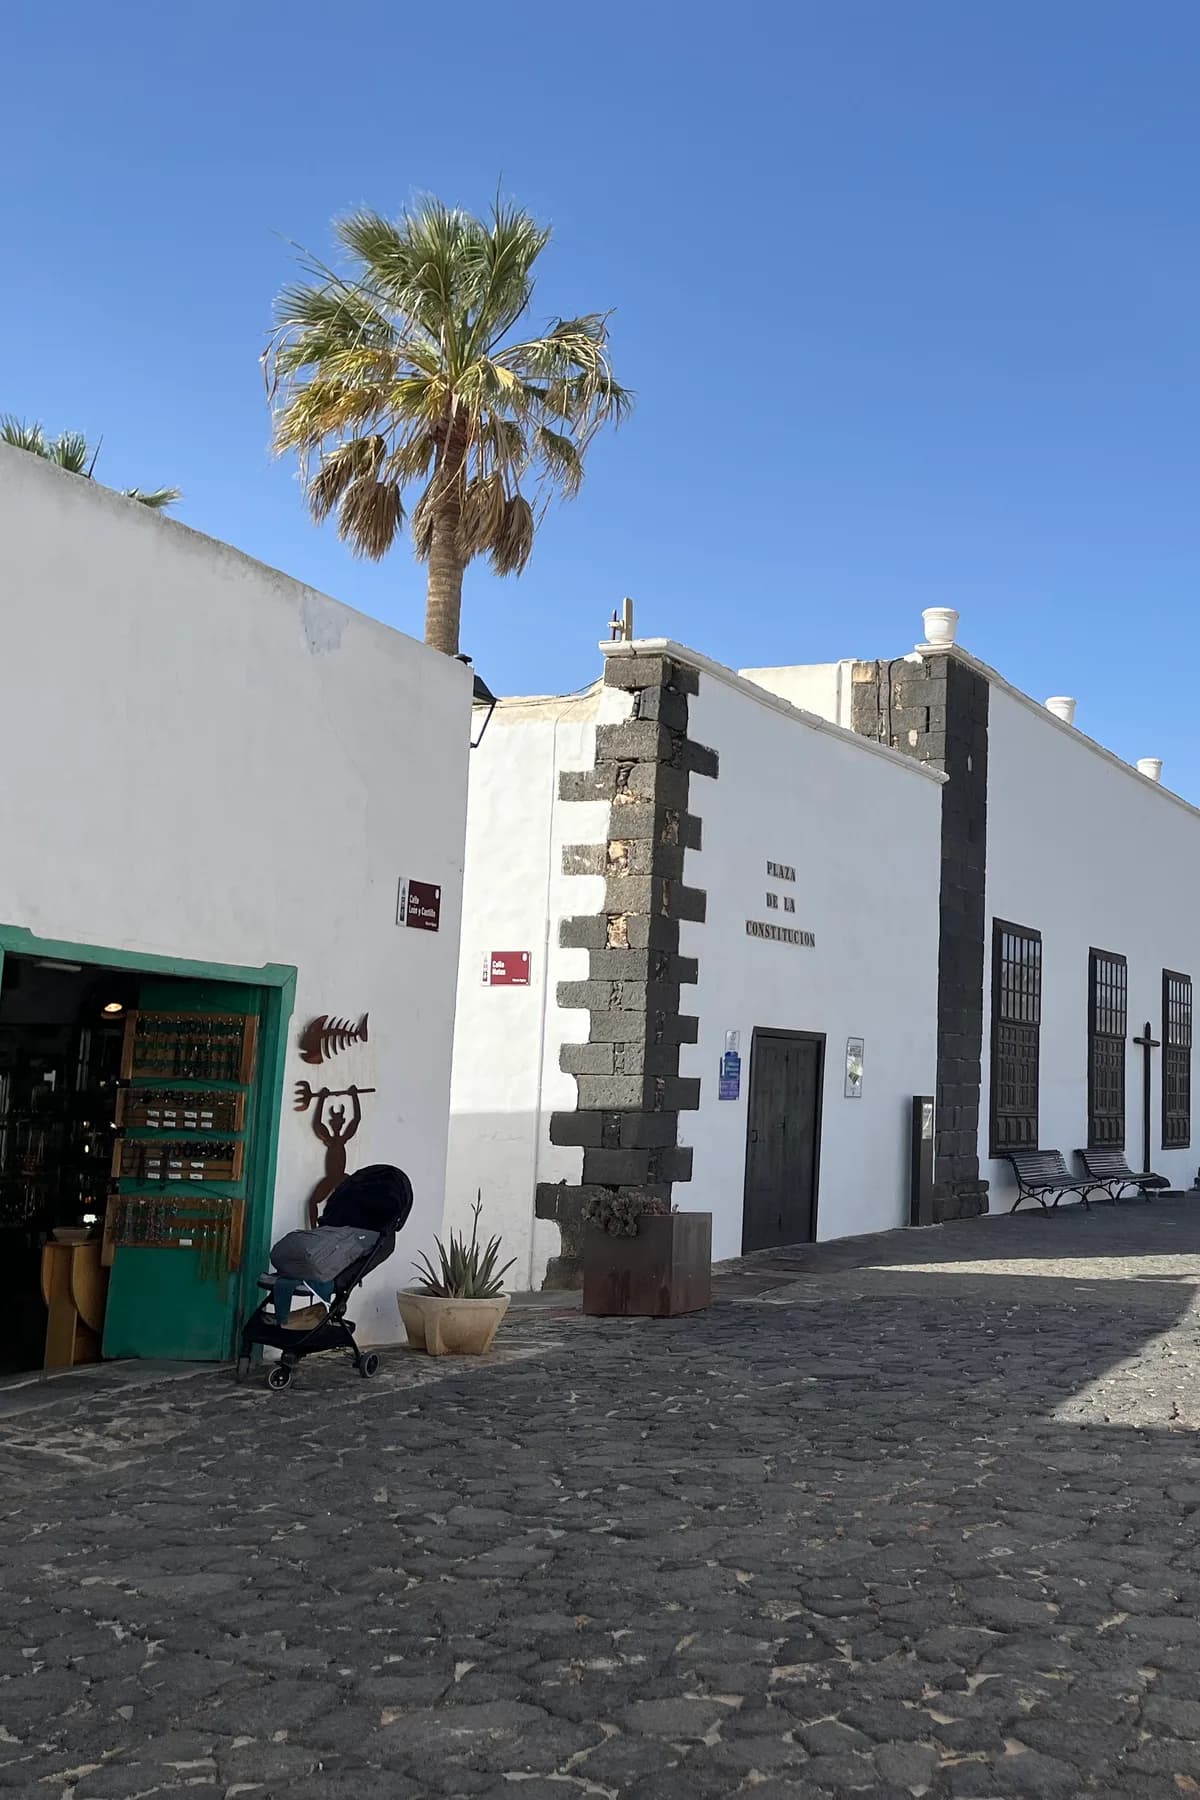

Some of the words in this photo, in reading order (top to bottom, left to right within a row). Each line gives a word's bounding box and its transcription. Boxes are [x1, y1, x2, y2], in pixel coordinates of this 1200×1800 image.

[766, 860, 796, 882] PLAZA
[766, 892, 778, 909] DE
[784, 896, 795, 913] LA
[745, 919, 815, 947] CONSTITUCION
